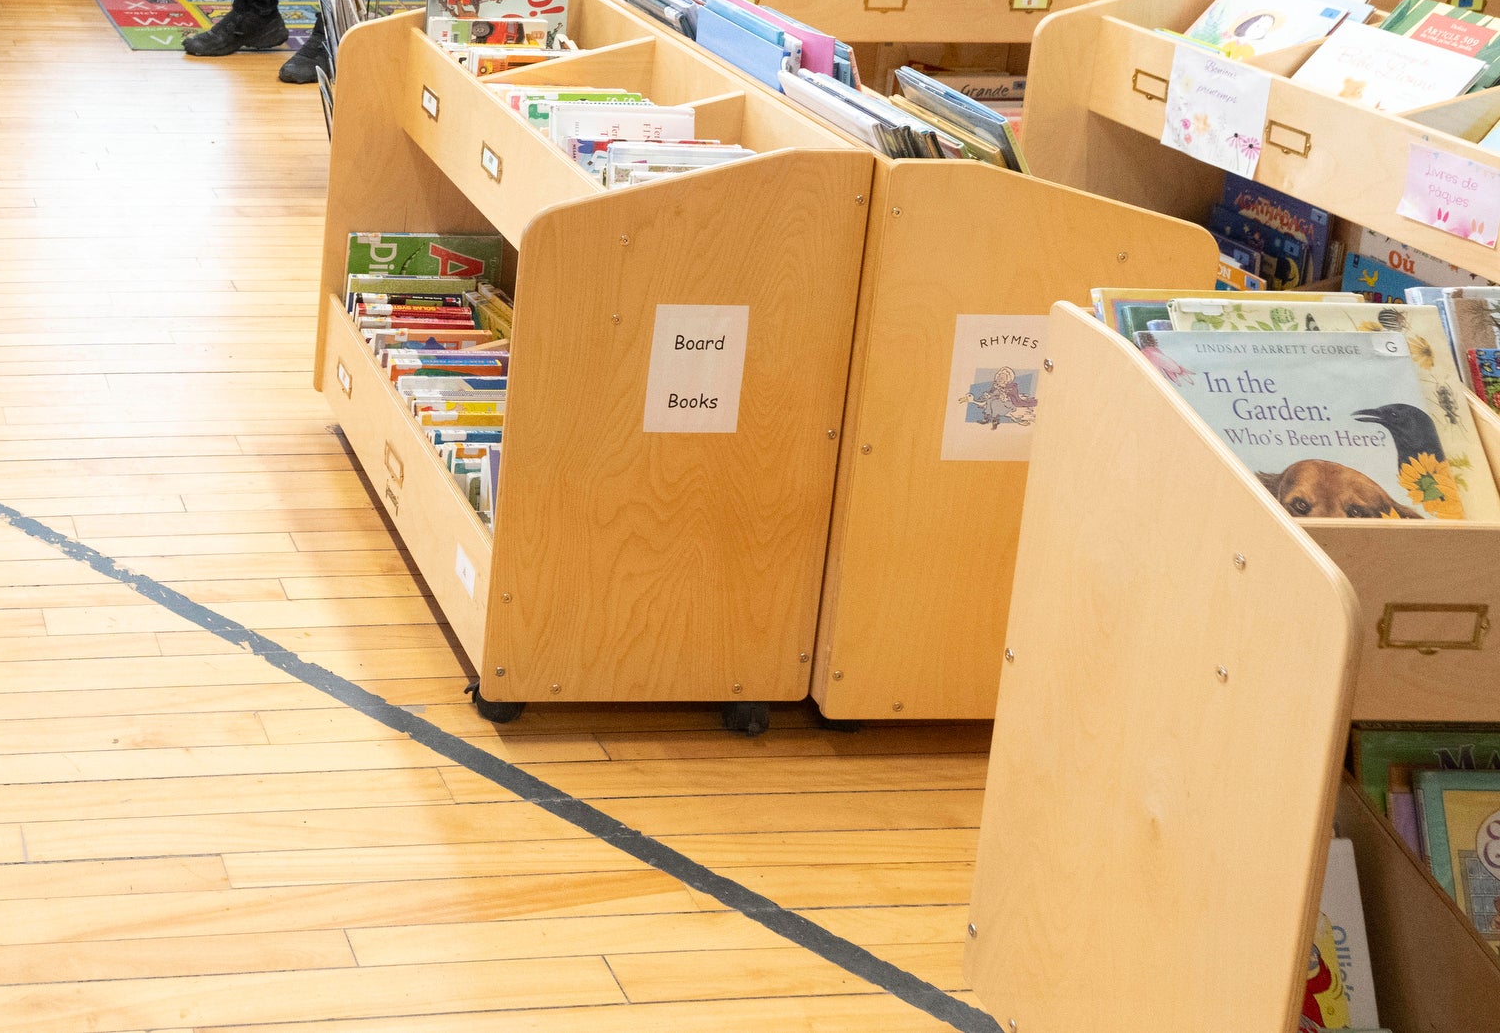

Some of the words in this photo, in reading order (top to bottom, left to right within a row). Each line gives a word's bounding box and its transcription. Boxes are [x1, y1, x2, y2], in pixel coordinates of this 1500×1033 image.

[1423, 25, 1460, 41] ARTICLE
[959, 84, 1010, 98] Grande
[1196, 85, 1238, 105] printemps
[1425, 165, 1458, 186] Livres
[1461, 177, 1480, 192] de
[1427, 181, 1470, 209] Pâques
[1388, 249, 1417, 274] Où
[674, 334, 726, 351] Board
[979, 334, 1039, 350] RHYMES
[1196, 343, 1250, 356] LINDSAY
[1252, 343, 1308, 356] BARRETT
[1311, 343, 1361, 356] GEORGE
[1384, 340, 1399, 354] G
[1204, 371, 1235, 394] In
[1237, 371, 1277, 394] the
[667, 393, 718, 409] Books
[1232, 398, 1332, 422] Garden:
[1223, 427, 1284, 448] Who's
[1288, 428, 1333, 448] Been
[1335, 429, 1387, 449] Here?
